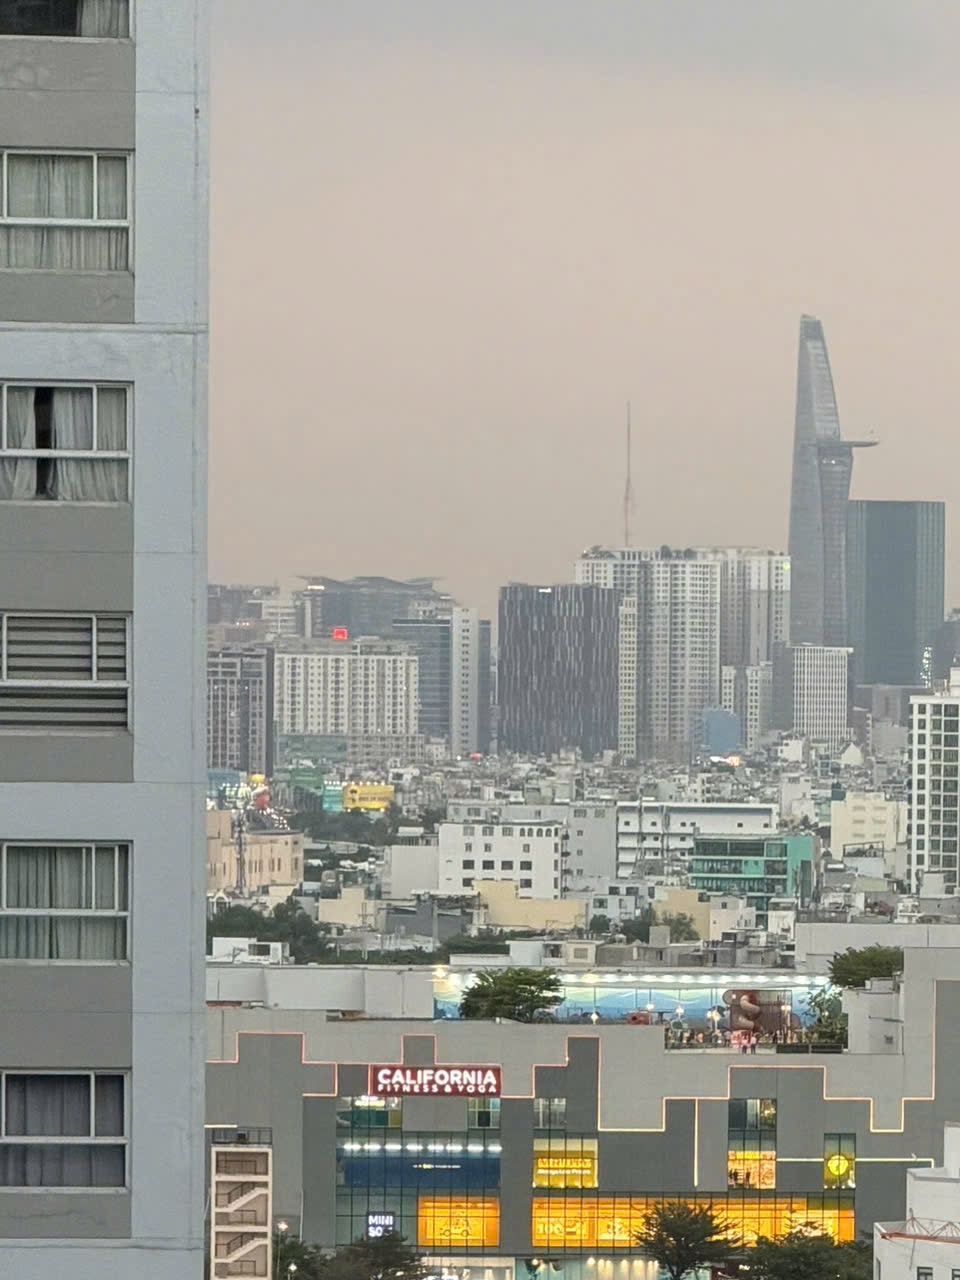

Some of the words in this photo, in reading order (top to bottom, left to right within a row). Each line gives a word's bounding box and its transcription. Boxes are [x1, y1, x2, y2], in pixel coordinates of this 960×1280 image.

[377, 1069, 497, 1085] CALIFORNIA
[378, 1085, 438, 1093] FITNESS
[444, 1085, 452, 1093] &
[458, 1085, 497, 1093] YOGA
[368, 1215, 394, 1226] MINI
